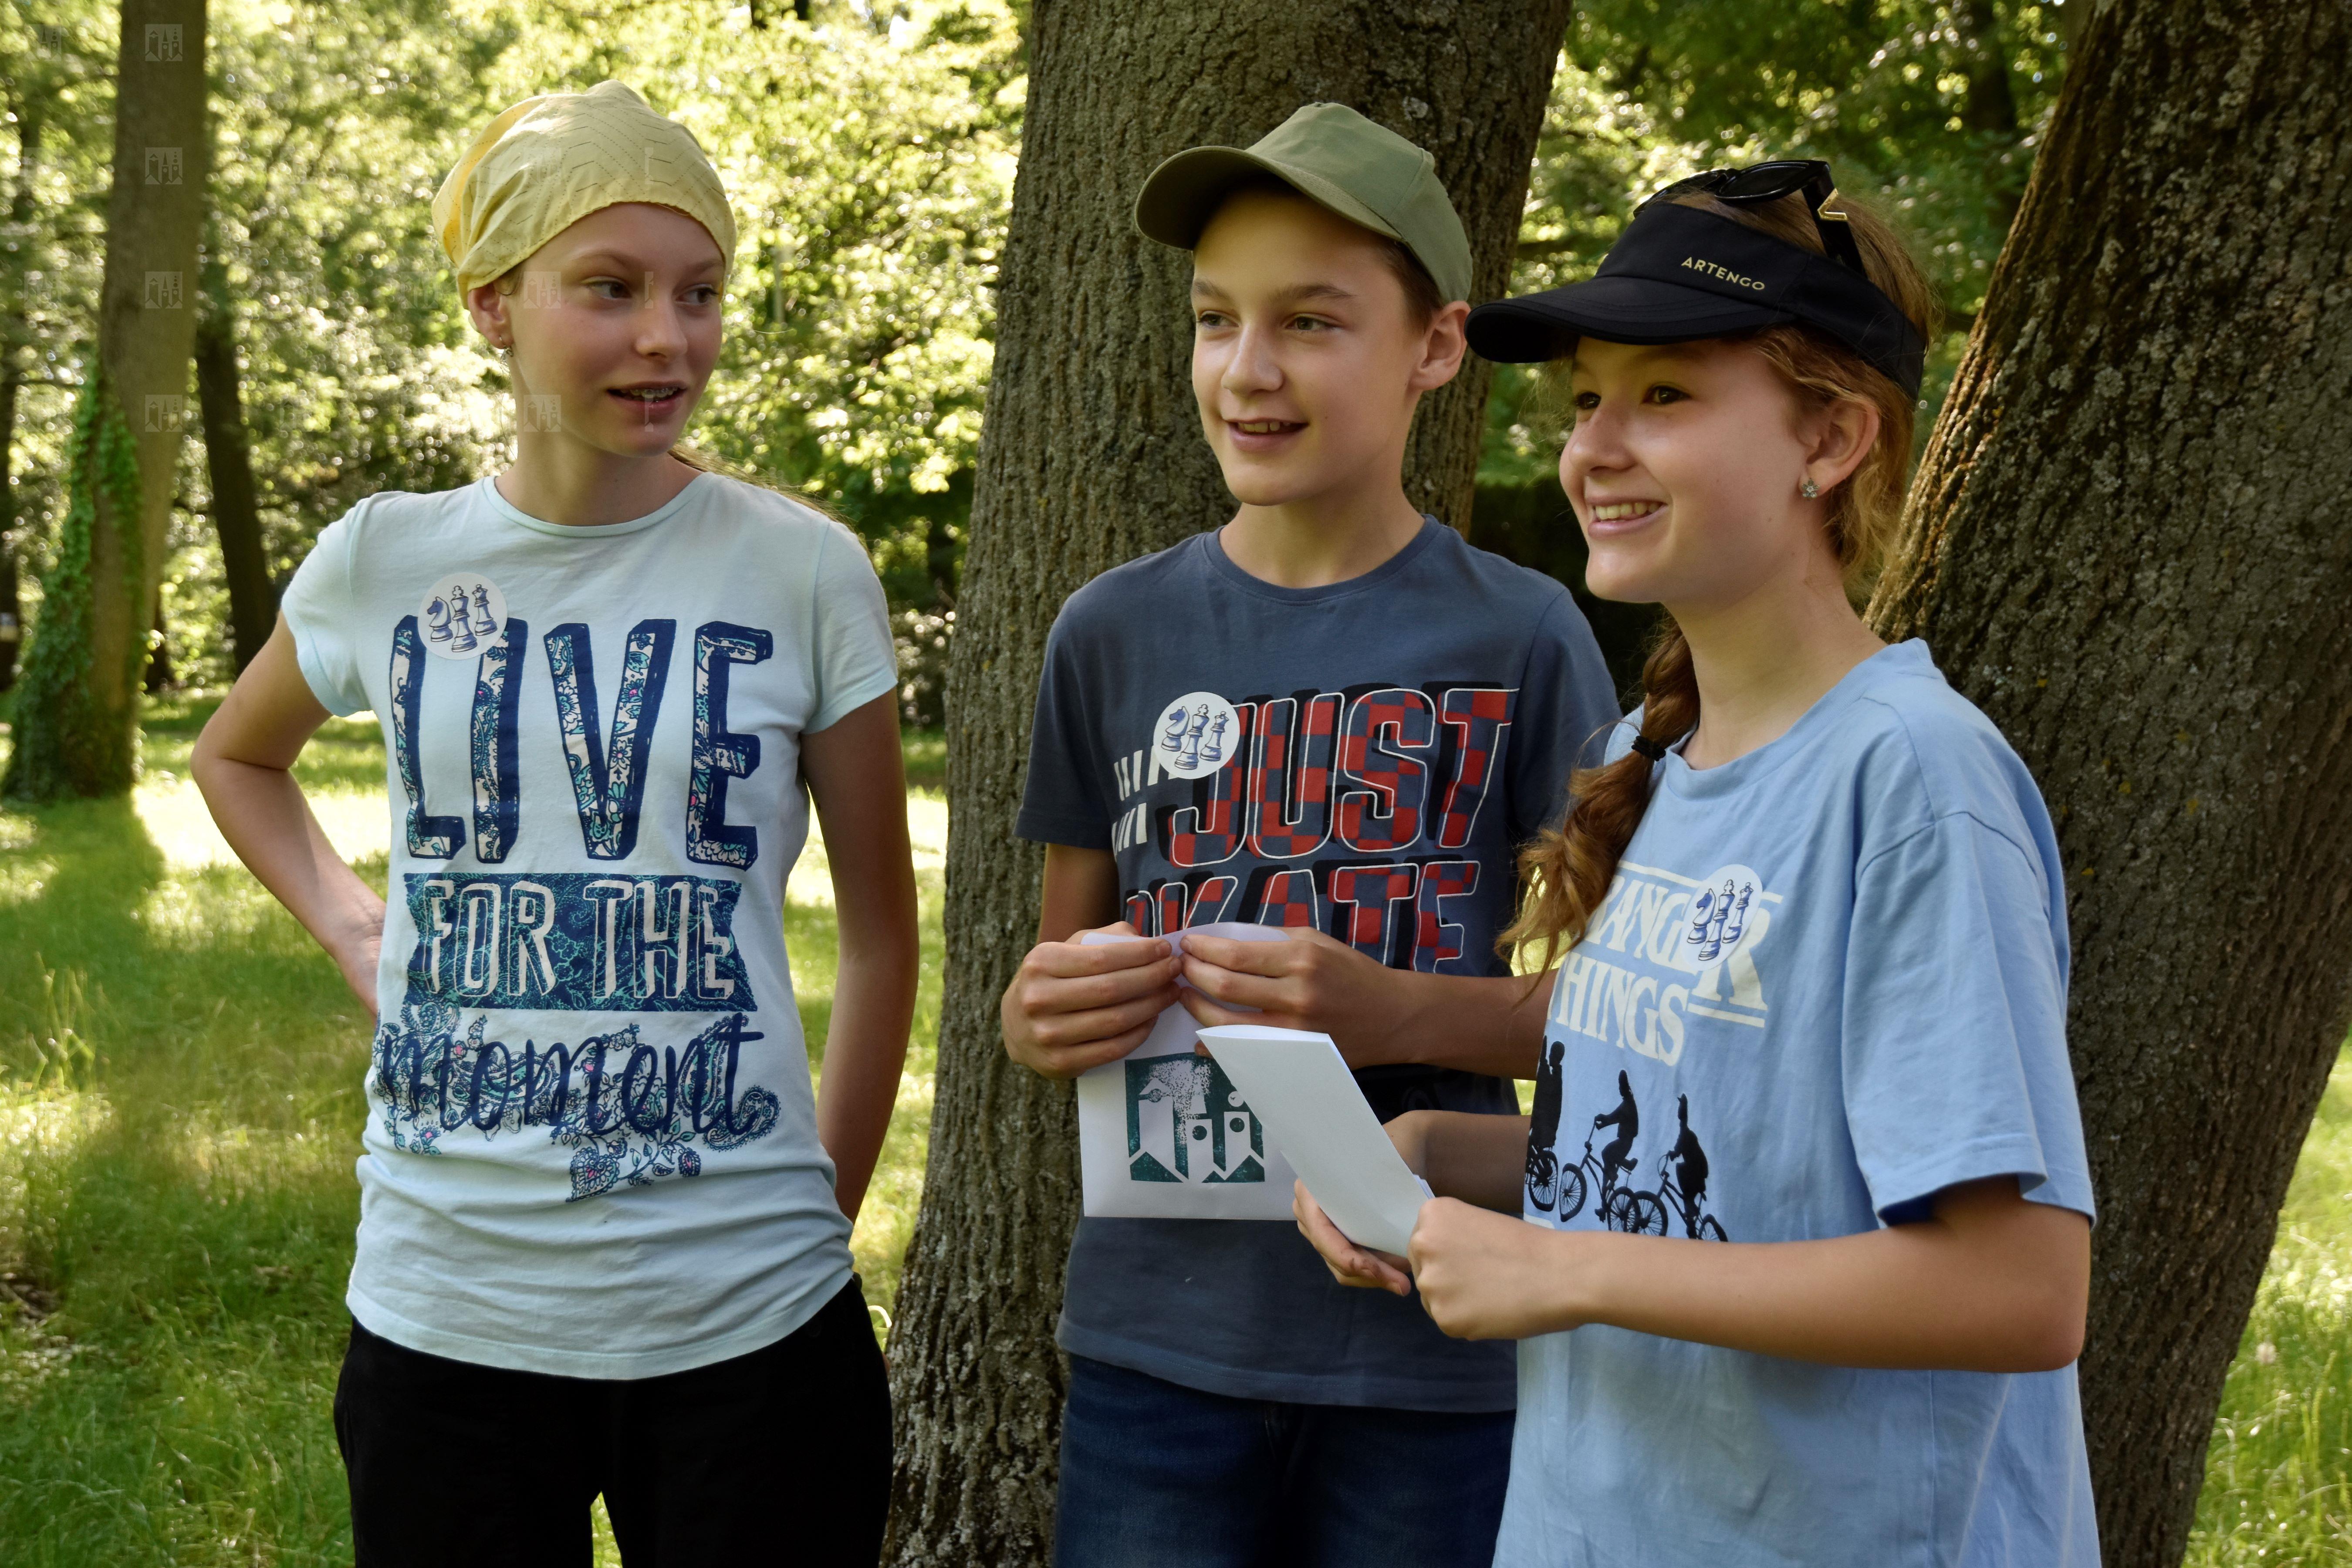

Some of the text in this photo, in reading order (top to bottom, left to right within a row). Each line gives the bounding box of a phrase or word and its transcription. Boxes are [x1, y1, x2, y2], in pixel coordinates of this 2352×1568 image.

[1681, 256, 1765, 291] ARTENGO
[389, 615, 774, 871] LIVE
[1156, 682, 1520, 868] JUST
[422, 879, 736, 1001] FOR THE
[1546, 954, 1690, 1066] HINGS
[381, 1013, 765, 1135] moment
